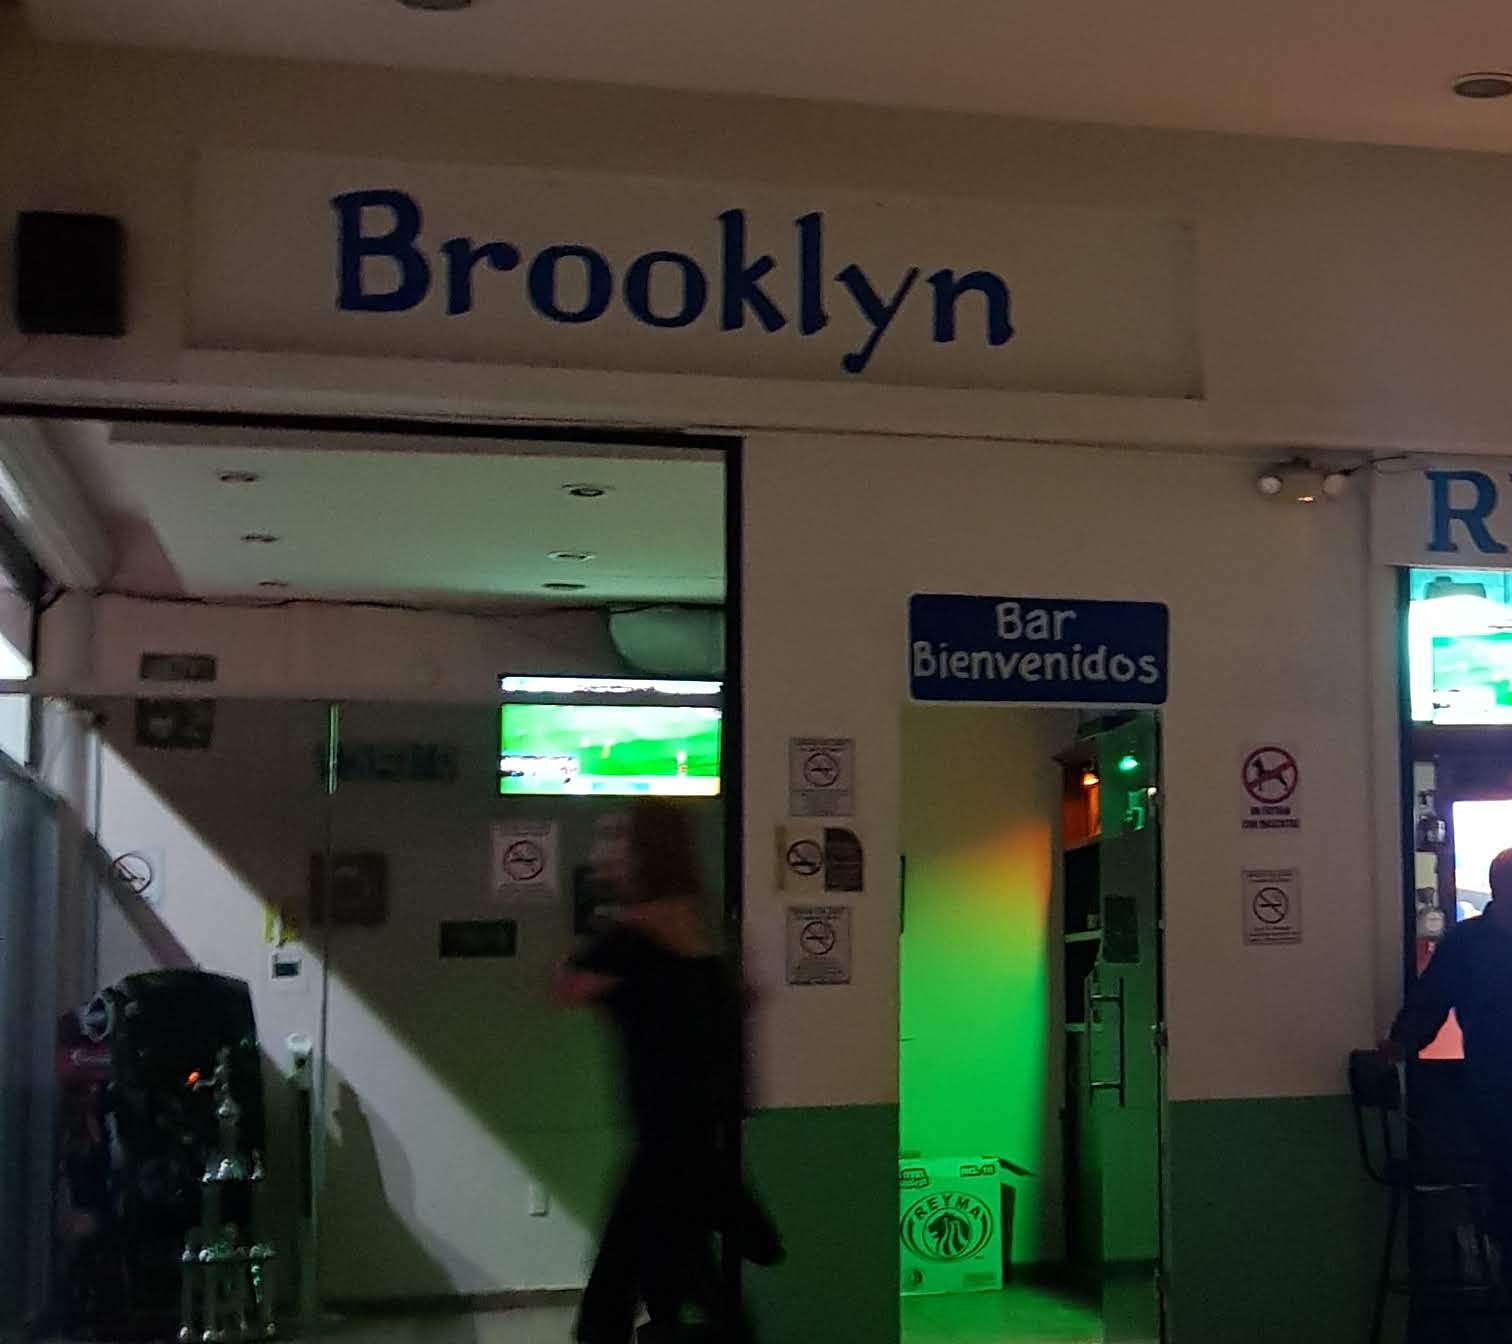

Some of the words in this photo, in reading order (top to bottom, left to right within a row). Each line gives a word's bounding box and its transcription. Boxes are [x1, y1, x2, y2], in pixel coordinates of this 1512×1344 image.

[331, 190, 1014, 374] Brooklyn
[995, 602, 1076, 640] Bar
[912, 640, 1160, 685] Bienvenidos
[914, 1193, 982, 1219] REYMA
